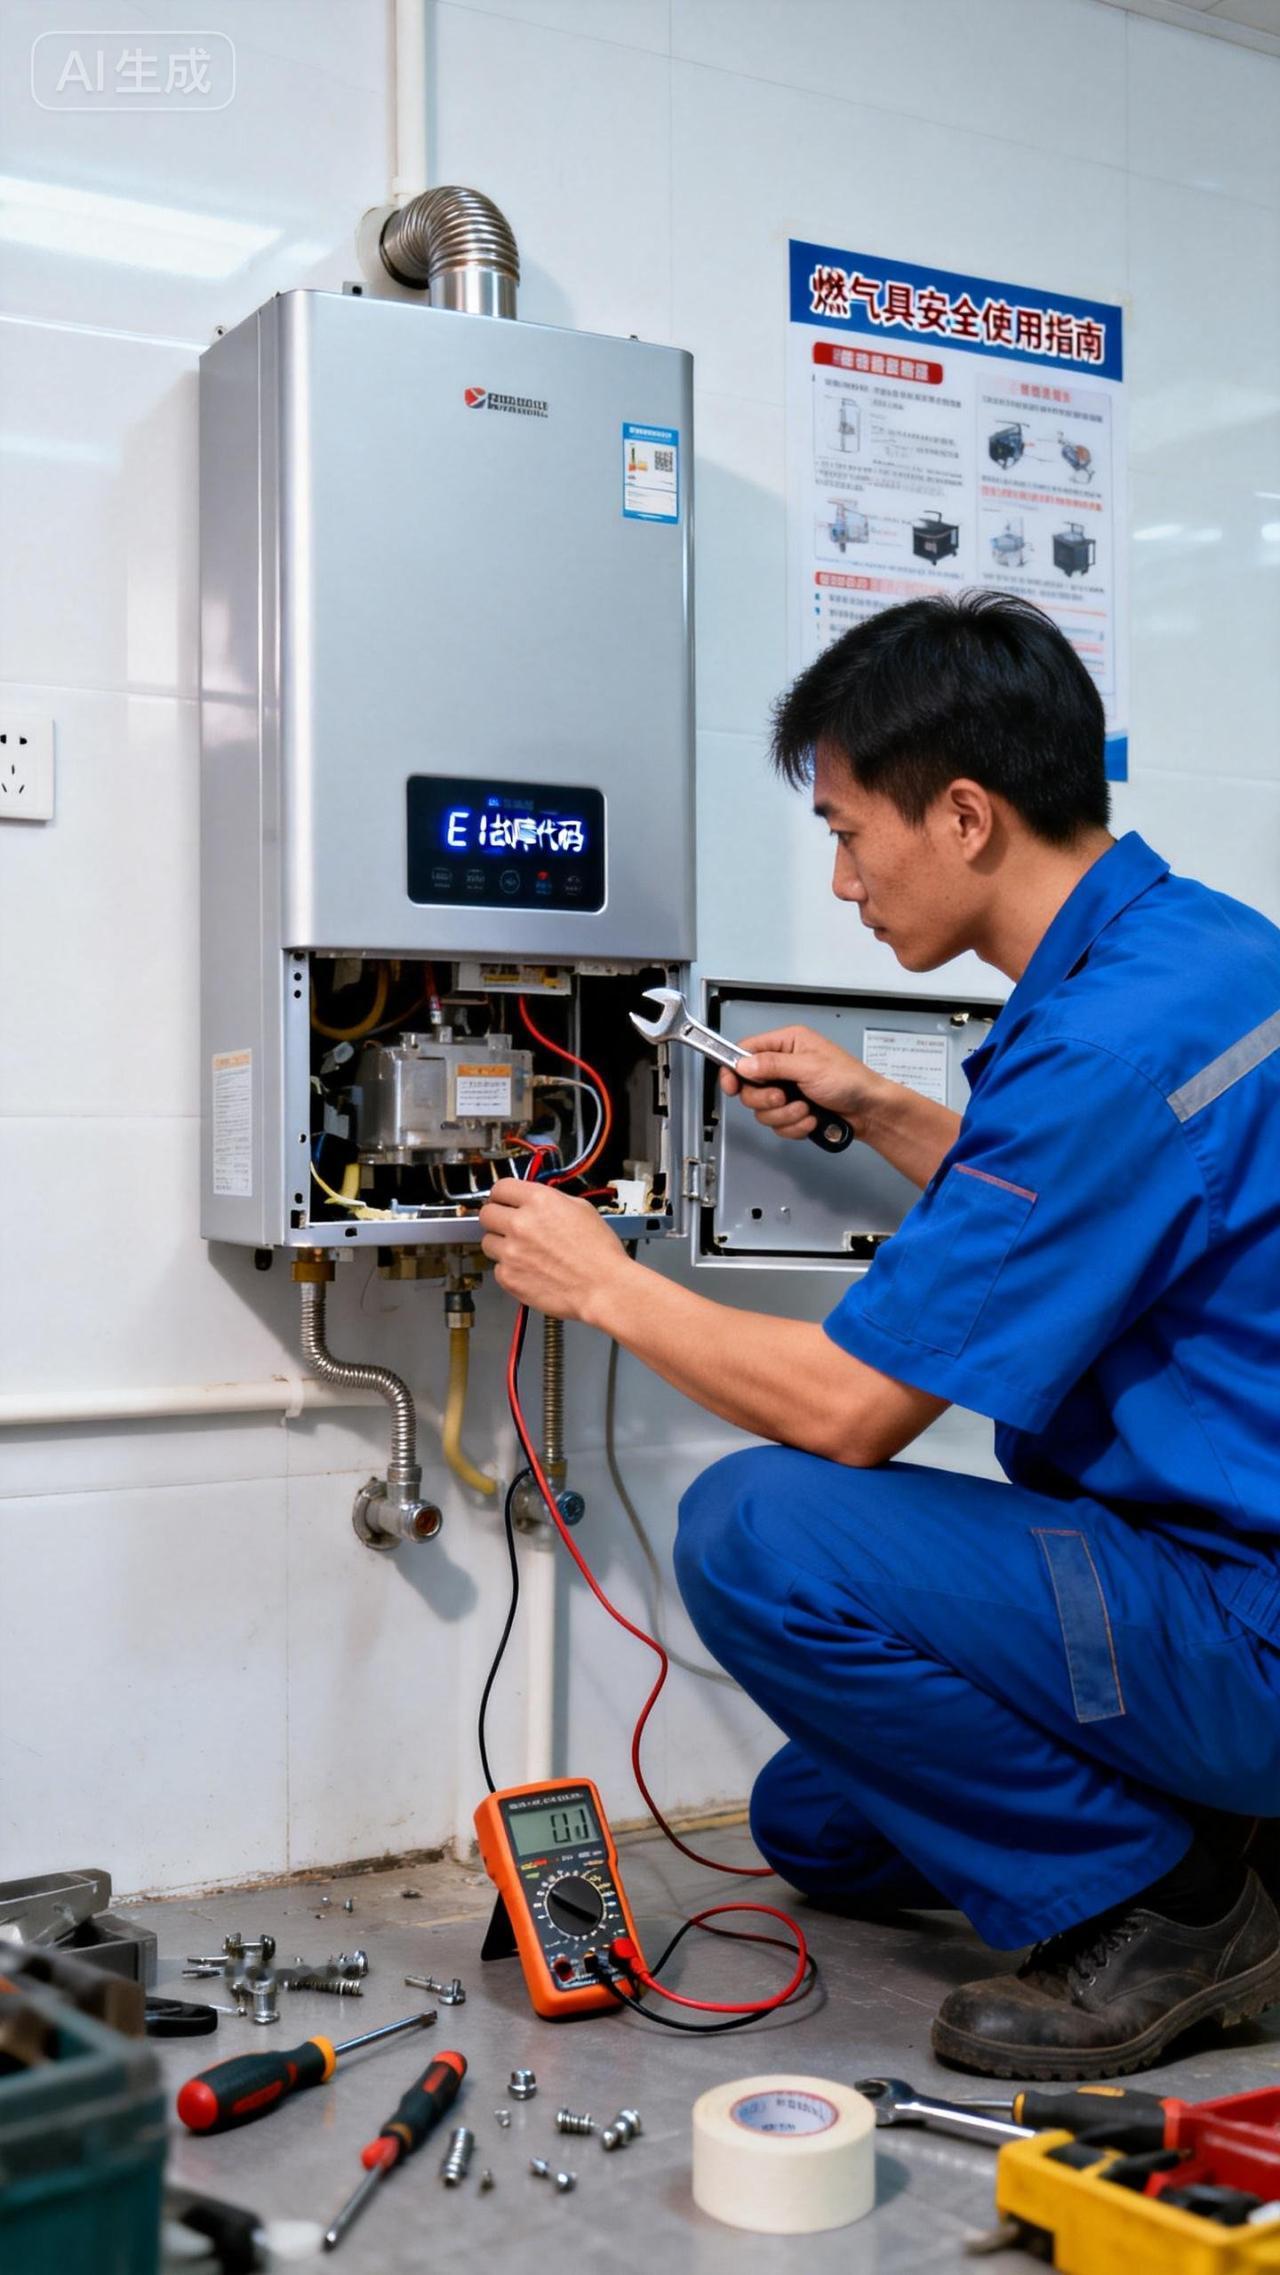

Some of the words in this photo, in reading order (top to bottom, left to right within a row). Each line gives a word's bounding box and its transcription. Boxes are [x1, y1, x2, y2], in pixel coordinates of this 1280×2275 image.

[810, 265, 1106, 363] 燃气具安全使用指南
